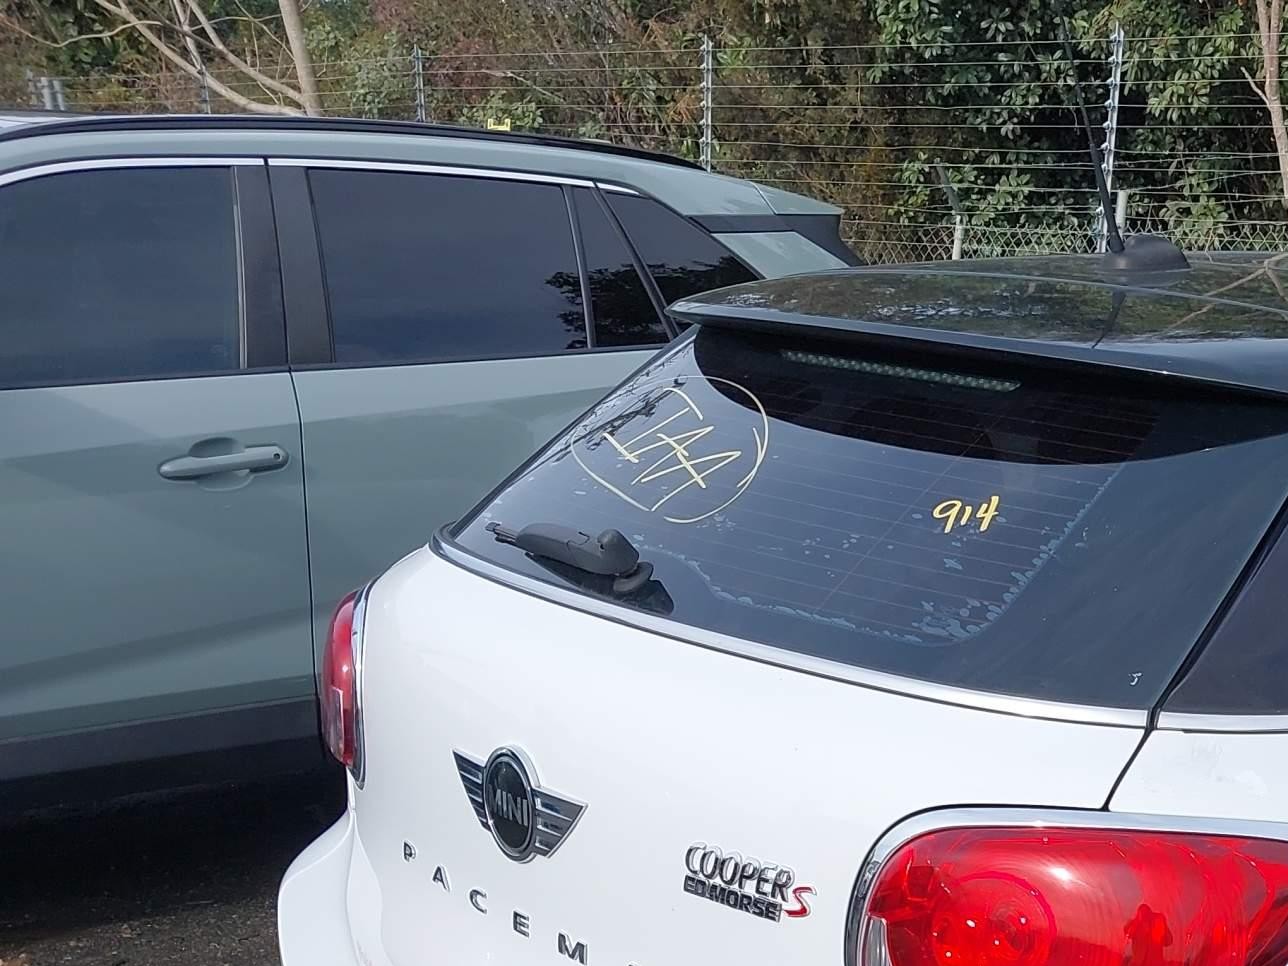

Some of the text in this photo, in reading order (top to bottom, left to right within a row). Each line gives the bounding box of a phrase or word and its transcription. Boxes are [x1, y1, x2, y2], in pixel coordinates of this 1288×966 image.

[932, 495, 1000, 534] 914
[486, 781, 528, 827] MINI
[684, 842, 818, 918] COOPER S
